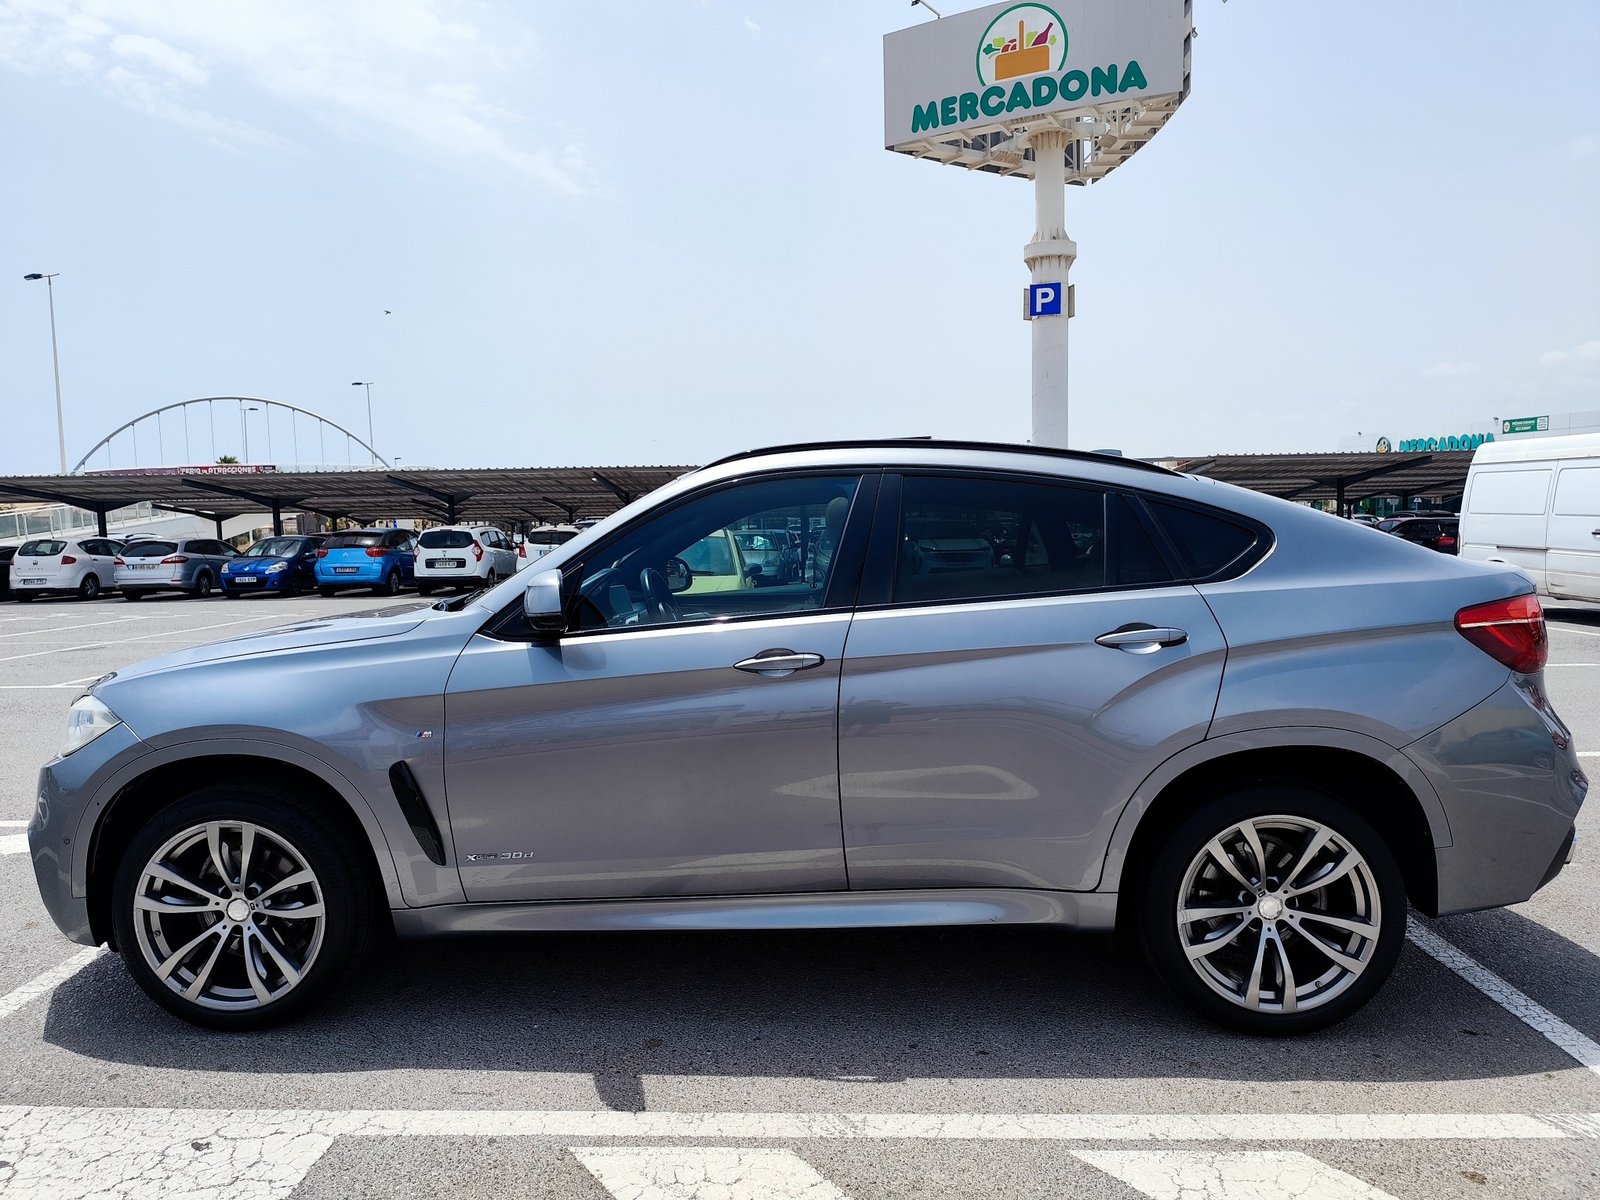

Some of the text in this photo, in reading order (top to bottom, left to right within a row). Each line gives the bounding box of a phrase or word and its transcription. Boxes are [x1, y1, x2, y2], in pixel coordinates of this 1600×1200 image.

[911, 60, 1148, 134] MERCADONA
[1035, 287, 1055, 313] P
[1399, 432, 1495, 452] MERCADONA
